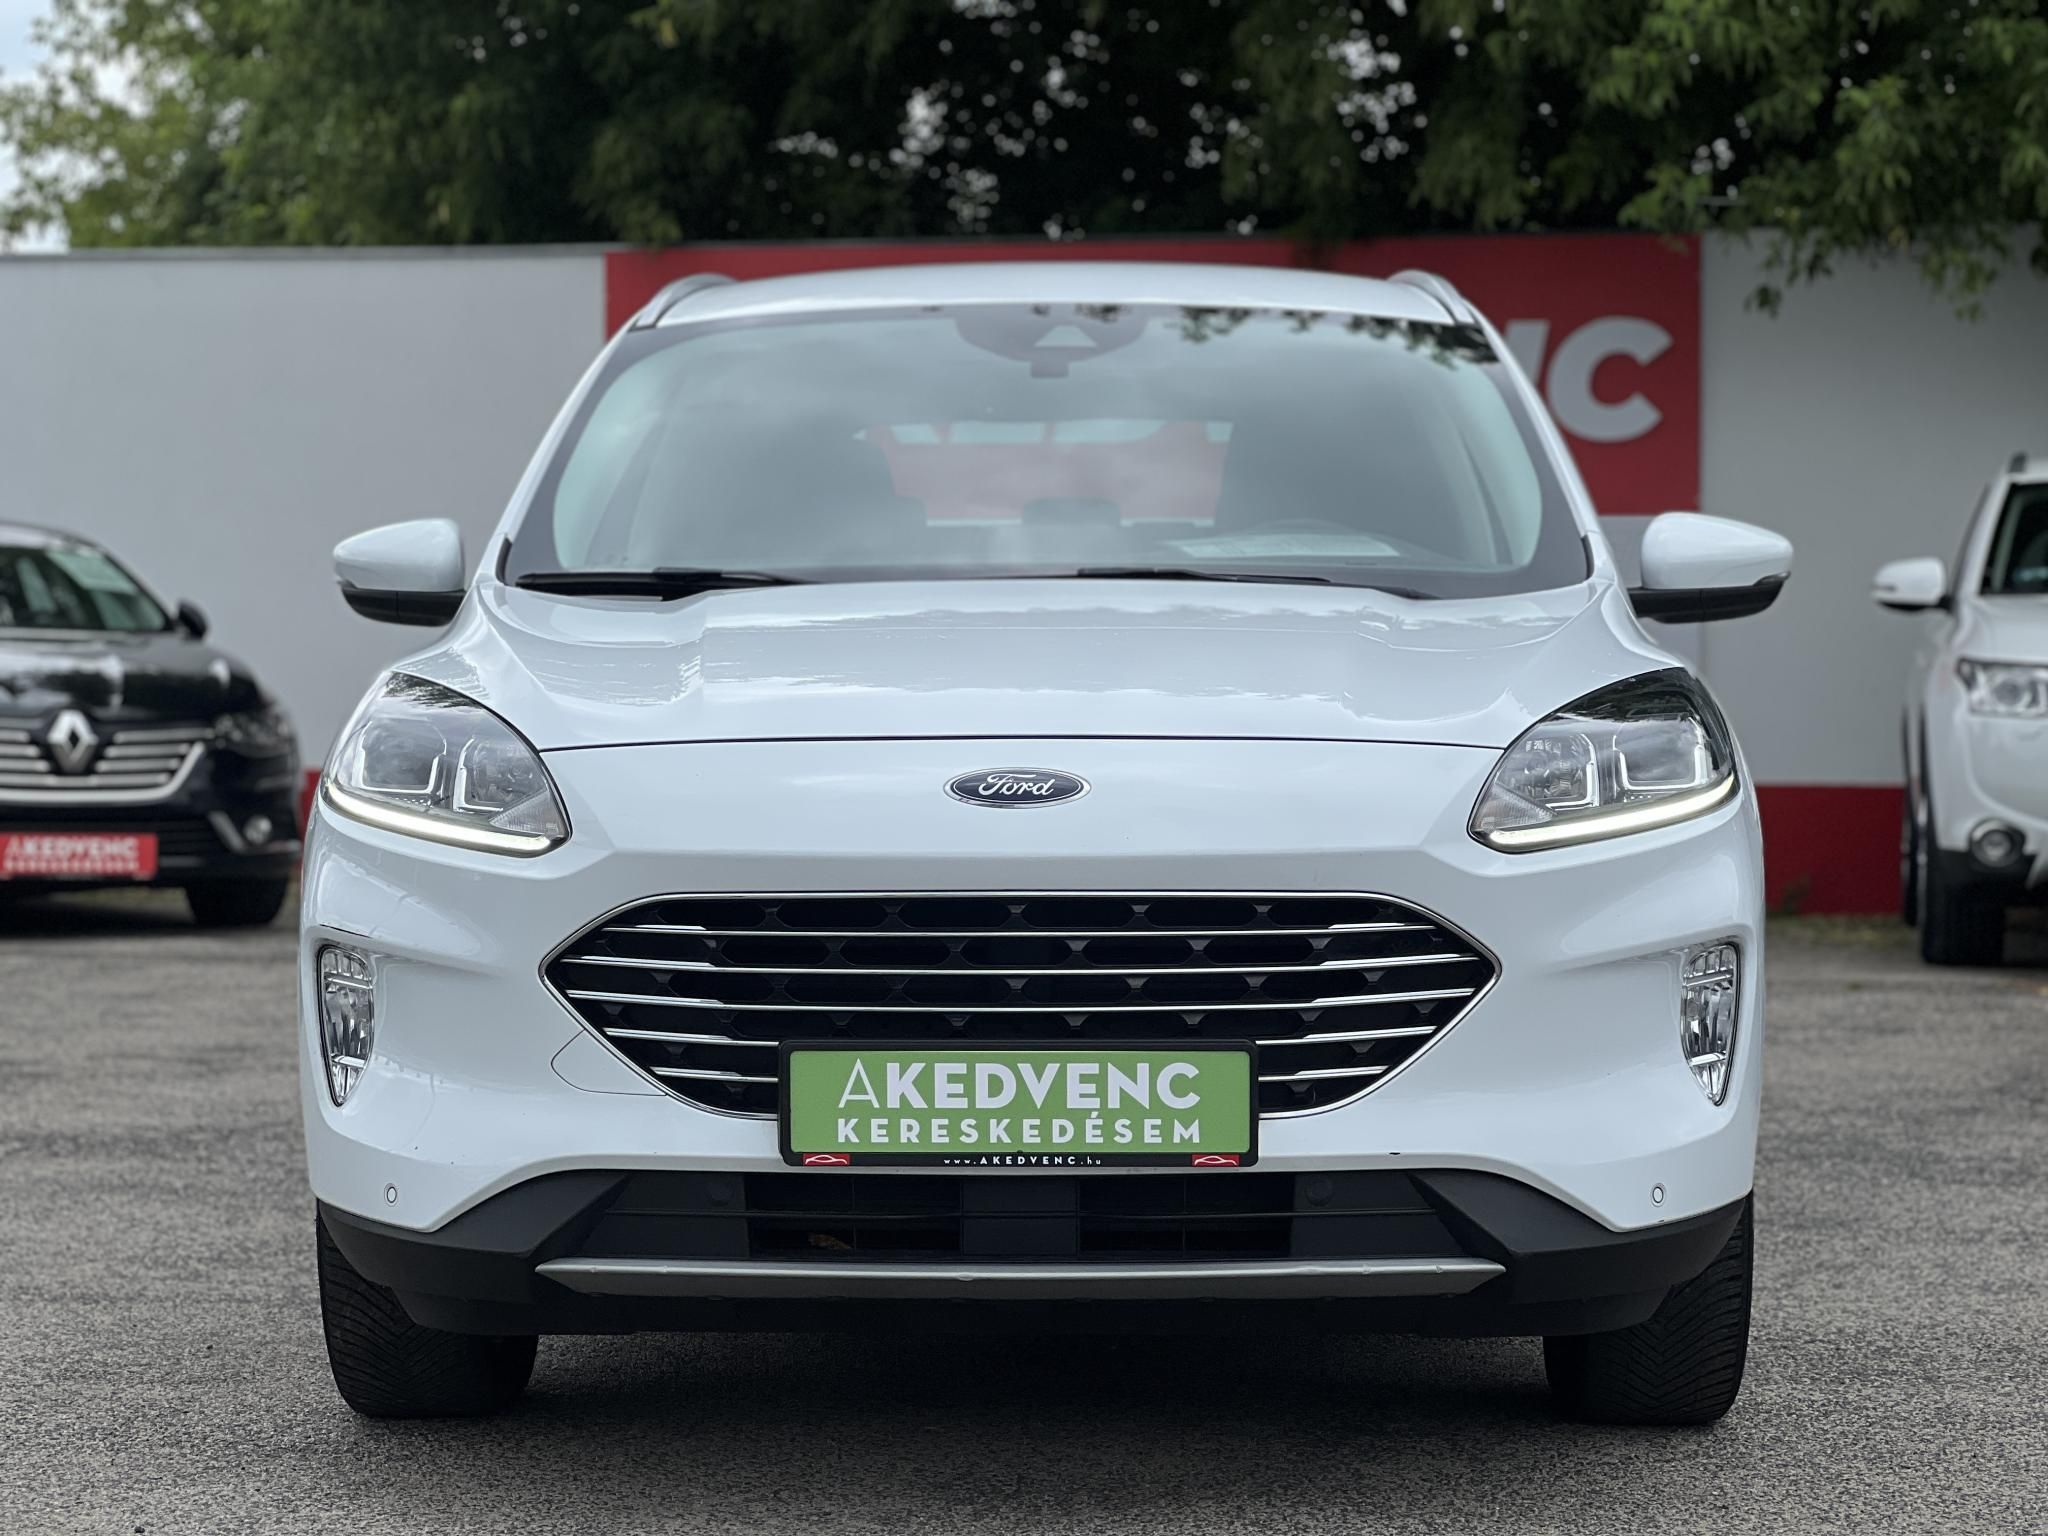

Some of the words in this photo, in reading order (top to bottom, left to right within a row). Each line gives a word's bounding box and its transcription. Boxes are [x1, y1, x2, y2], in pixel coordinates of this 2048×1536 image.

[978, 773, 1056, 796] Ford
[838, 1058, 1201, 1110] AKEDVENC
[838, 1112, 1201, 1144] KERESKEDÉSEM
[943, 1155, 1102, 1167] www.AKEDVENC.hu
